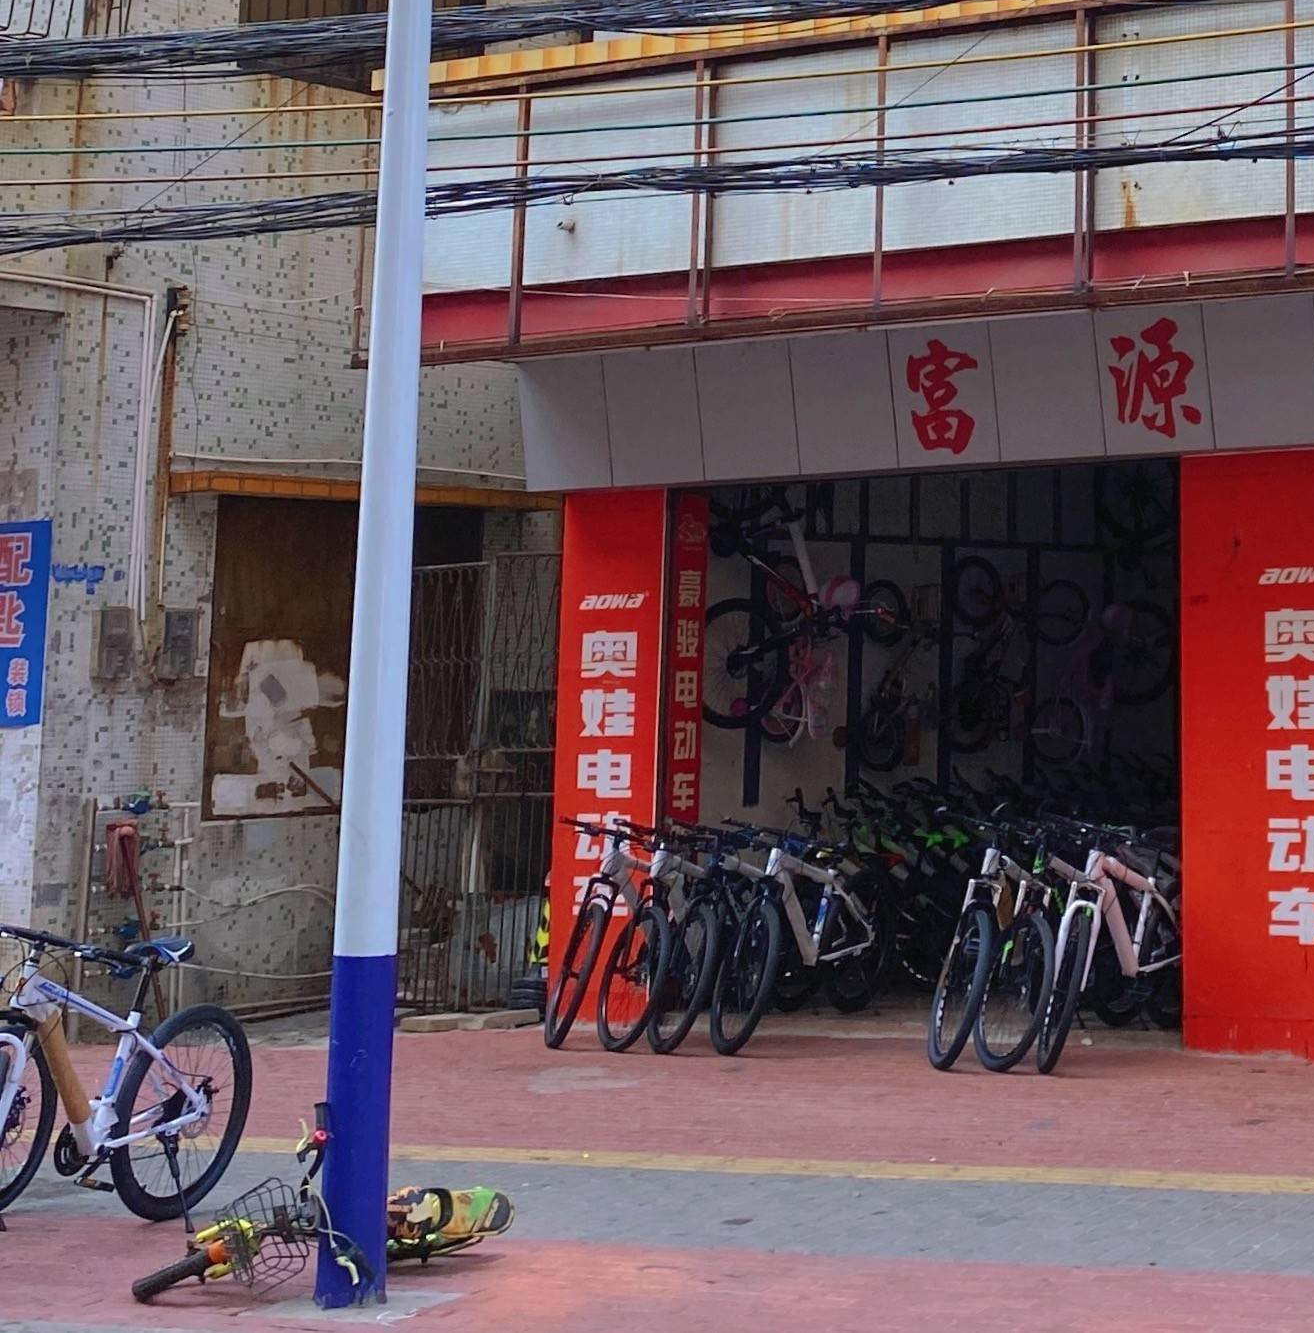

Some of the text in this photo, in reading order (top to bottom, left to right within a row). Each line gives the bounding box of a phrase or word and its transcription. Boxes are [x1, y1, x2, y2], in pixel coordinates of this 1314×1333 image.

[672, 571, 701, 810] 豪骏电动车
